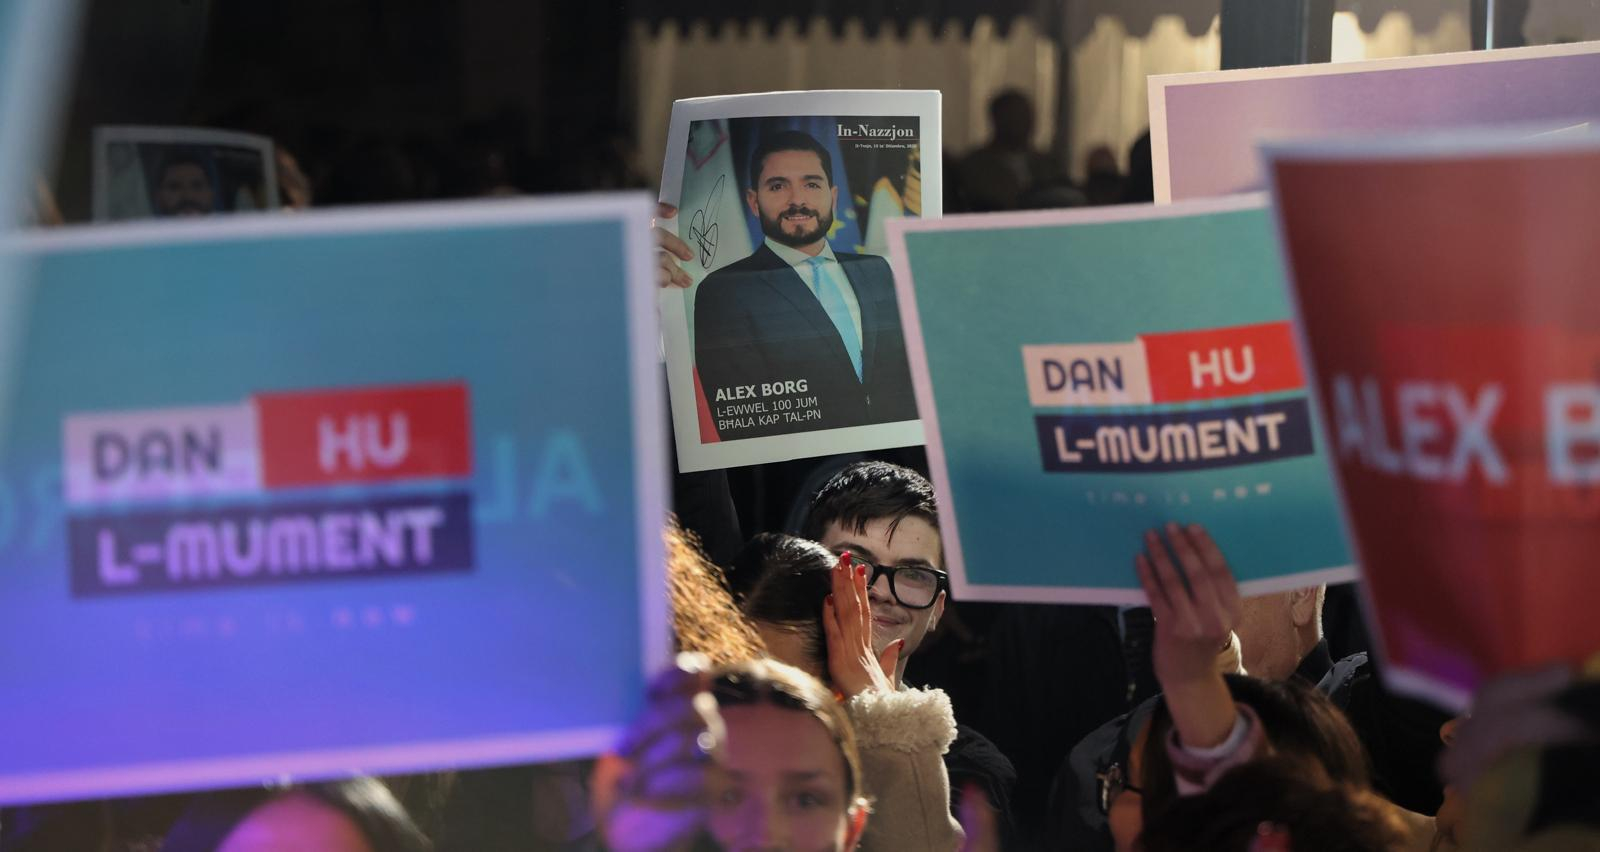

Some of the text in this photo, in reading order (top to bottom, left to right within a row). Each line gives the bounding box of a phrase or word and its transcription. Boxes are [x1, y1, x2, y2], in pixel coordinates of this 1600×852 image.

[837, 124, 914, 141] In-Nazzjon
[715, 379, 808, 402] ALEX BORG
[1042, 345, 1256, 392] DAN HU
[717, 396, 818, 417] L-EWWEL 100 JUM
[759, 413, 780, 426] KAP
[783, 409, 821, 423] TAL-PN
[1333, 372, 1511, 488] ALEX
[90, 410, 411, 482] DAN HU
[1054, 412, 1287, 464] L-MUMENT
[98, 507, 444, 586] L-MUMENT
